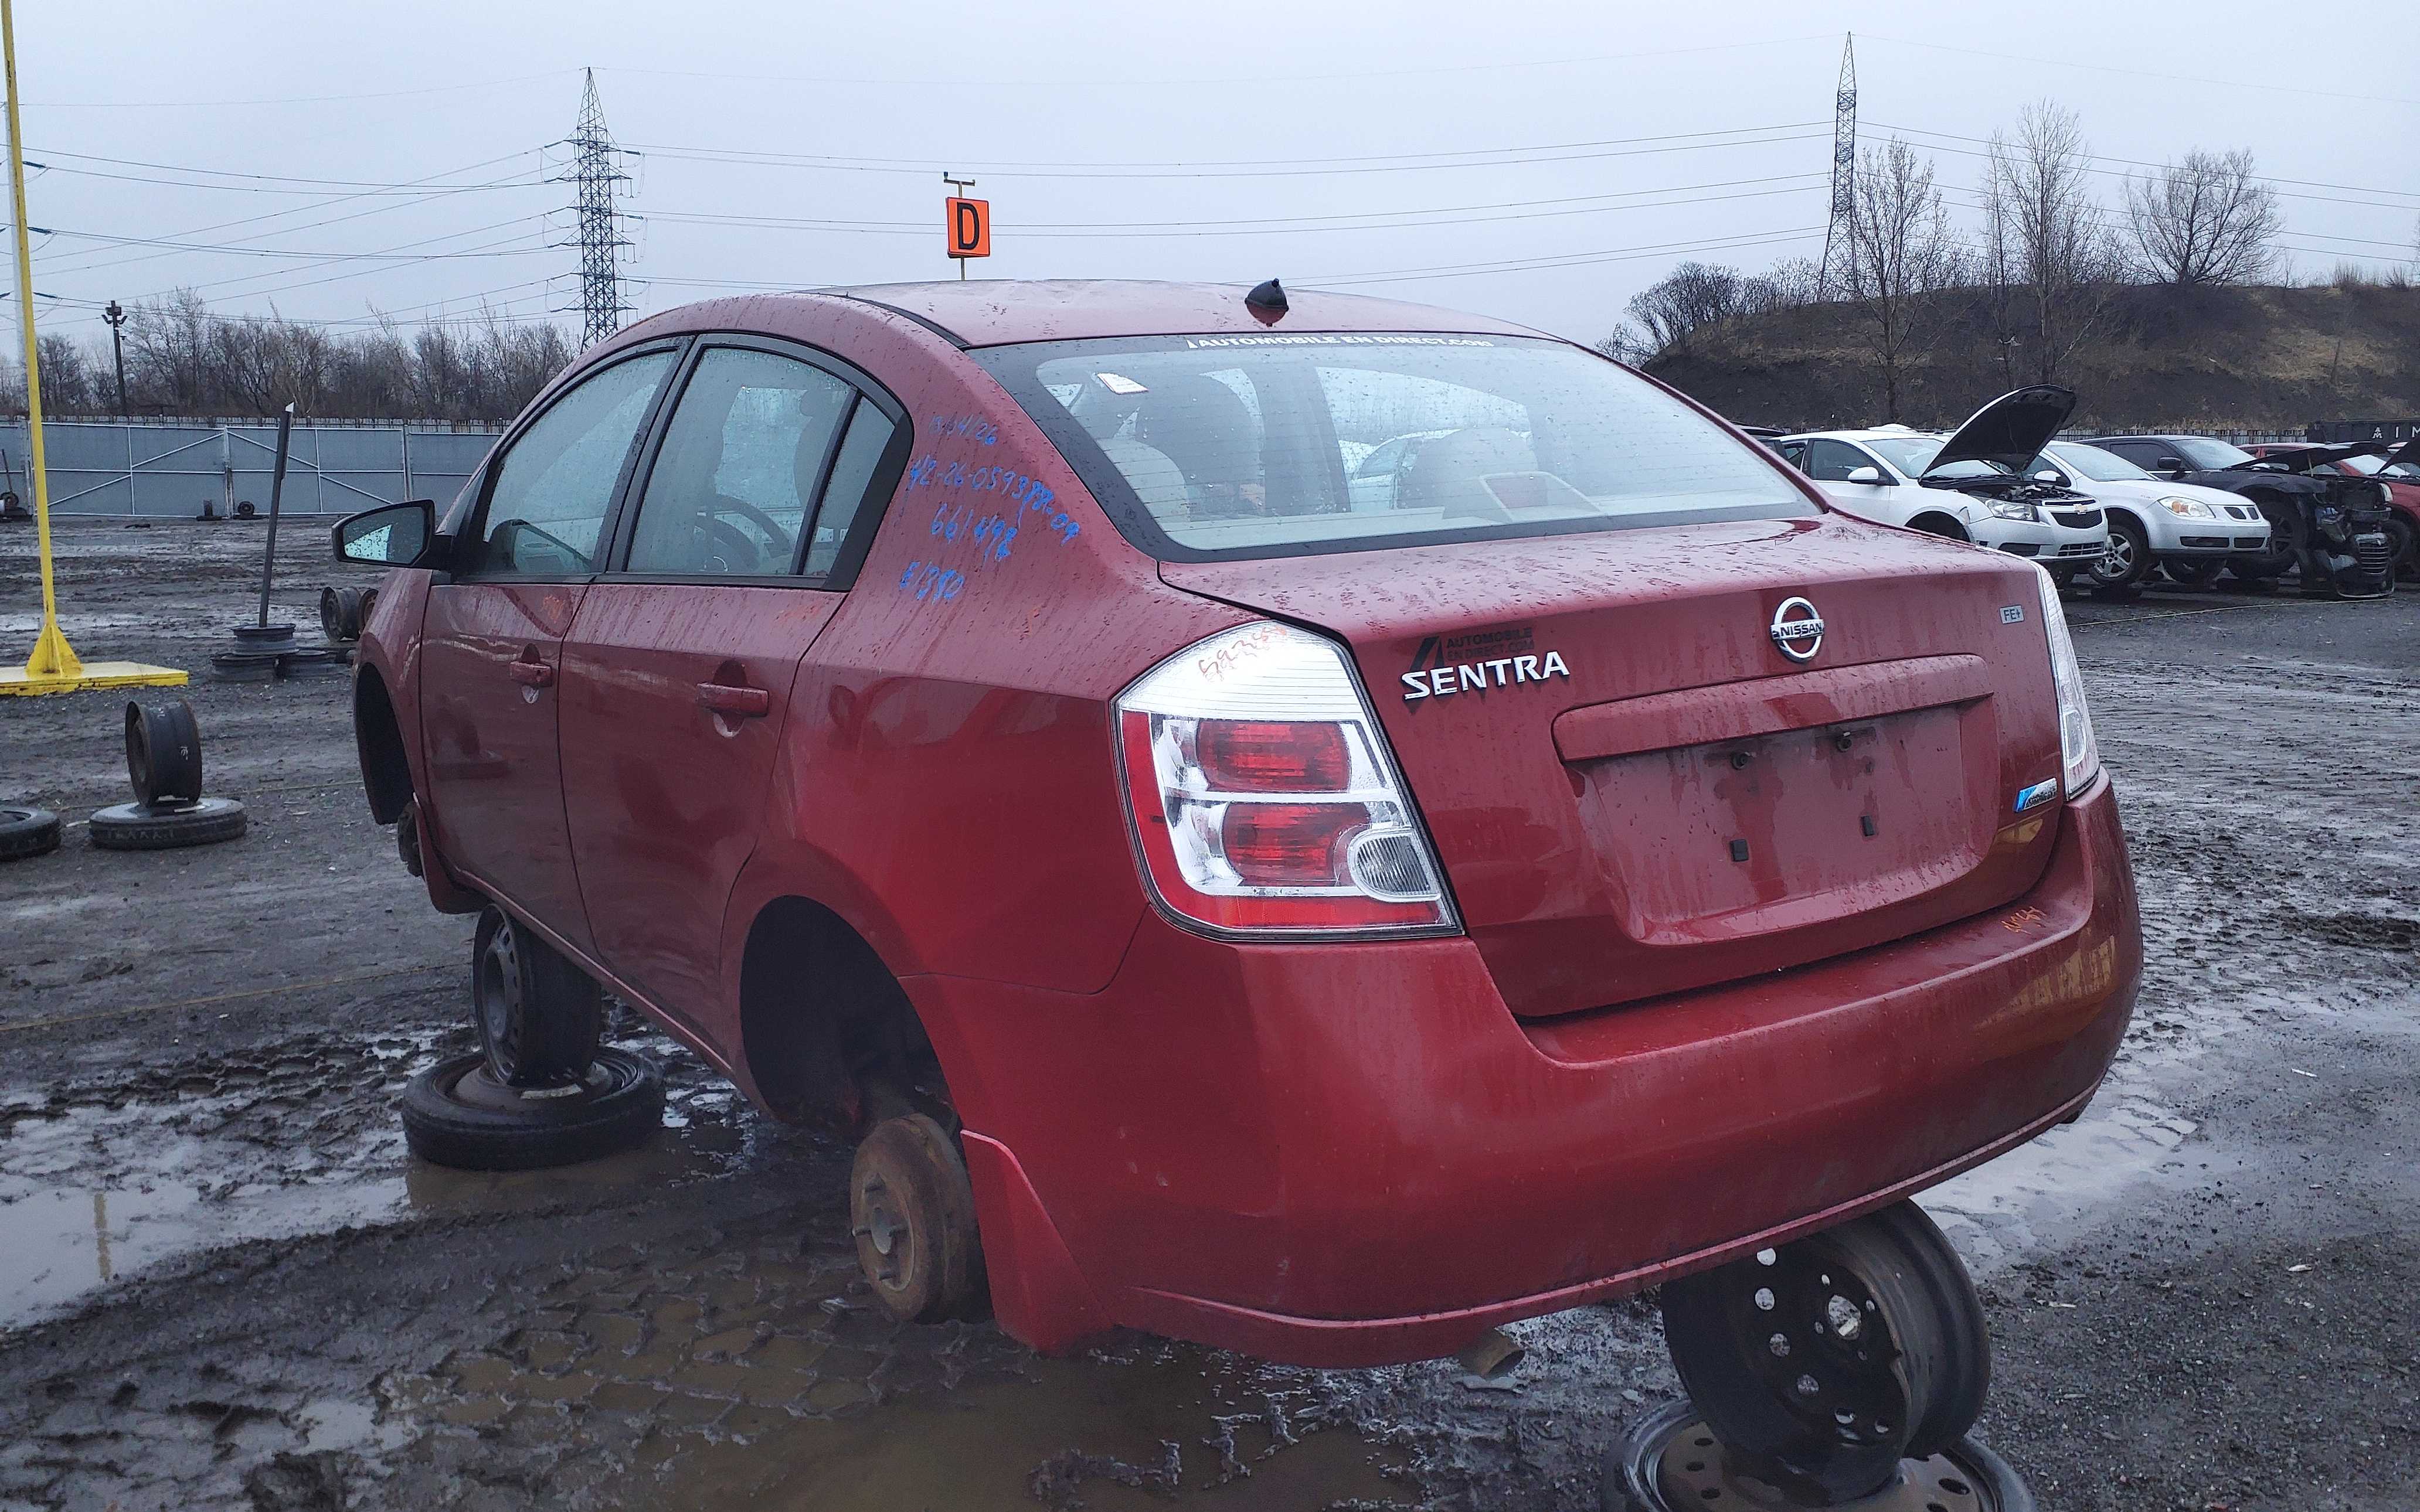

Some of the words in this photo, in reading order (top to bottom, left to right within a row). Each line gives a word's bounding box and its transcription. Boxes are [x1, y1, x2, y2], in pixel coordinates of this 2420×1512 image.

[957, 202, 980, 250] D
[1198, 336, 1341, 347] AUTOMOBILE
[1341, 336, 1374, 344] EN
[1372, 336, 1494, 348] DIRECT.COM
[1446, 627, 1533, 648] AUTOMOBILE
[1780, 622, 1823, 636] NISSAN
[1401, 651, 1571, 700] SENTRA
